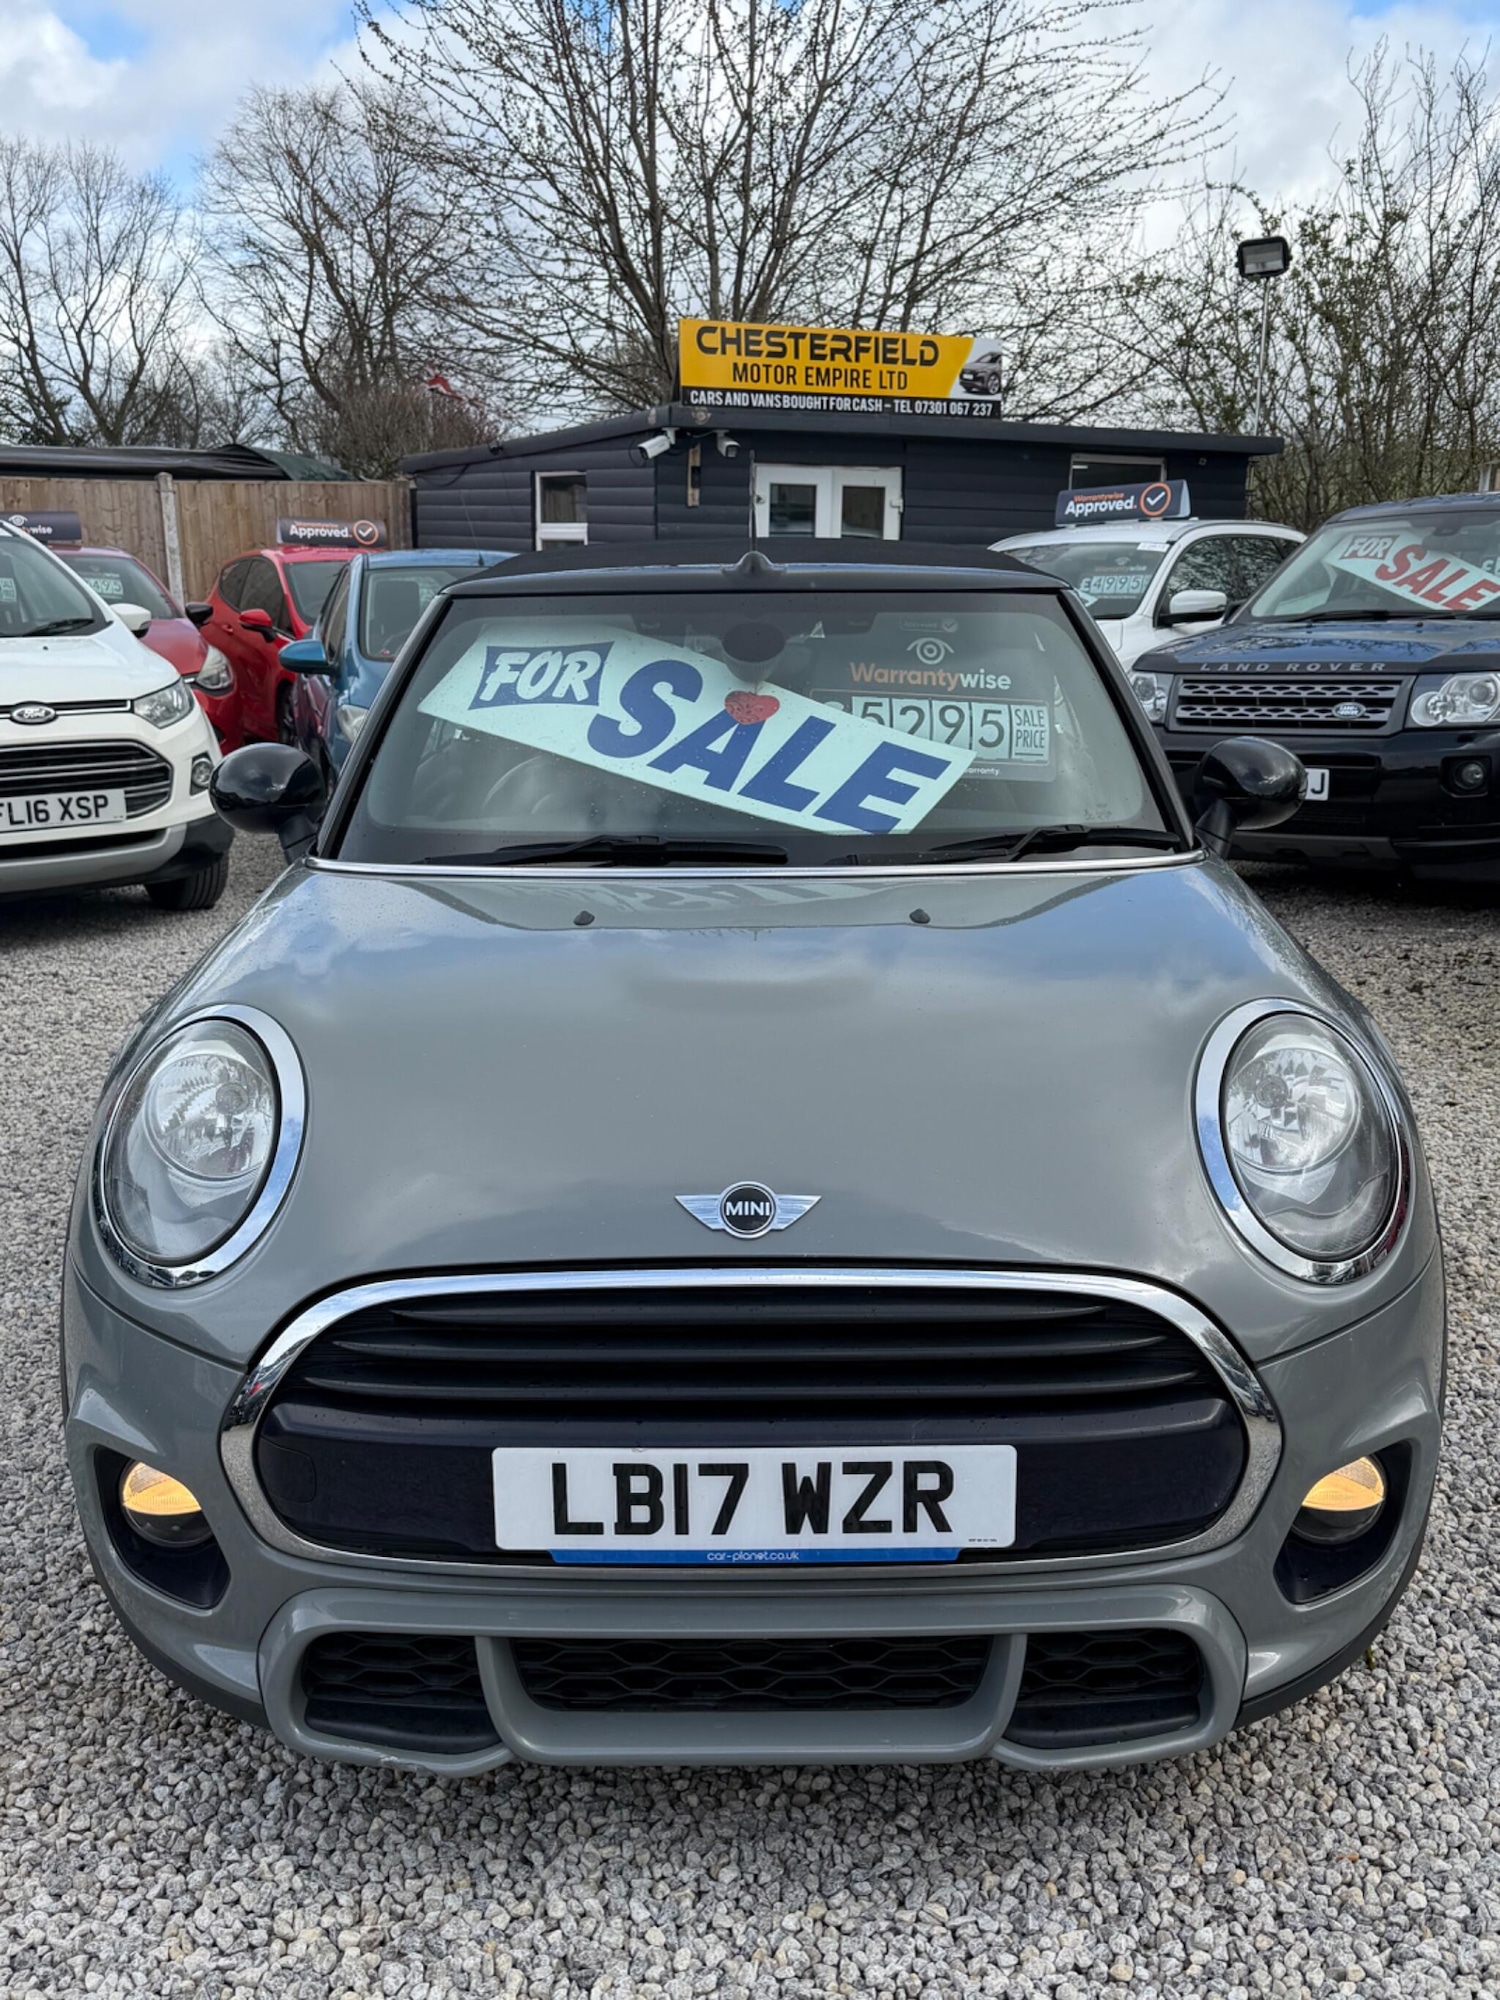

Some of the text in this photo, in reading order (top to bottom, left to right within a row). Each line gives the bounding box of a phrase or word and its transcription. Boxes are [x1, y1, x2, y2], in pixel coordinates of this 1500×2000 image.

[695, 325, 940, 367] CHESTERFIELD
[732, 362, 908, 390] MOTOR EMPIRE LTD
[690, 390, 723, 405] CARS
[724, 391, 749, 406] AND
[750, 393, 782, 408] VANS
[782, 394, 829, 410] BOUGHT
[829, 397, 850, 411] FOR
[852, 398, 882, 412] CASH
[894, 400, 912, 413] TEL
[915, 401, 947, 415] 07301
[950, 402, 969, 415] 067
[972, 403, 992, 417] 237
[1344, 537, 1393, 558] FOR
[1375, 543, 1500, 611] SALE
[479, 650, 600, 704] FOR
[849, 662, 1012, 692] Warrantywise
[1200, 662, 1387, 672] LAND ROVER
[824, 701, 1006, 749] 5295
[1014, 707, 1045, 729] SALE
[586, 658, 953, 836] SALE
[1014, 729, 1046, 749] PRICE
[58, 794, 109, 821] XSP
[725, 1200, 771, 1217] MINI
[551, 1460, 955, 1536] LB17 WZR
[706, 1550, 800, 1563] car-planet.co.uk
